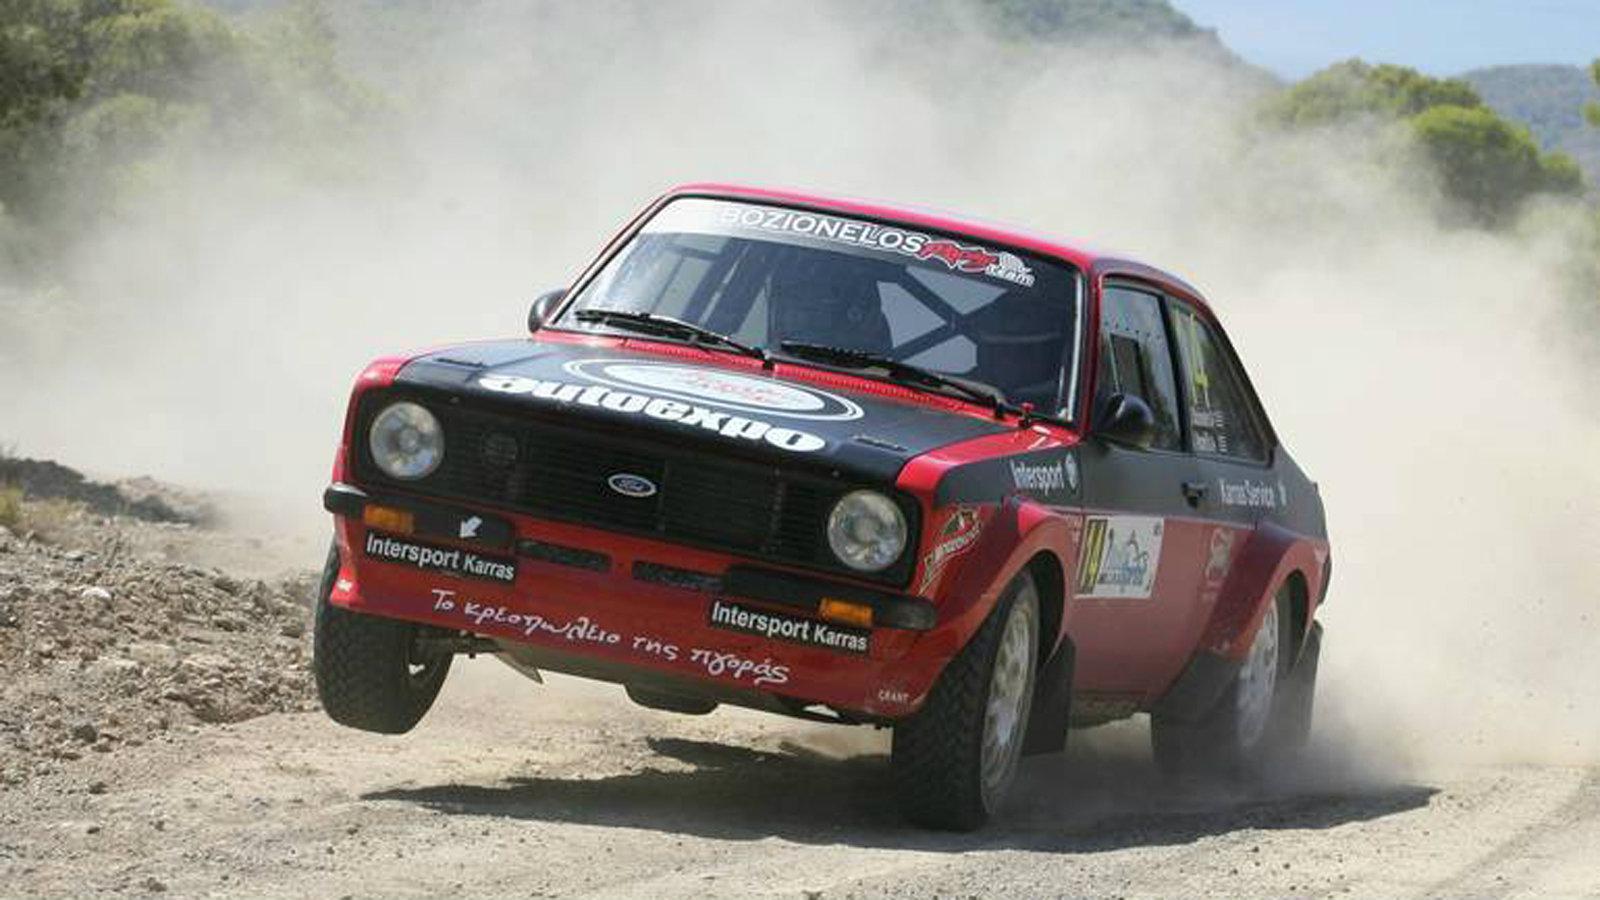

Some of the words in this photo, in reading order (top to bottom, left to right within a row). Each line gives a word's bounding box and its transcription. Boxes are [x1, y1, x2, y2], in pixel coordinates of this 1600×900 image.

[720, 205, 929, 255] BOZIONELOS
[478, 374, 826, 454] autoexpo
[1009, 458, 1065, 496] Intersport
[366, 532, 461, 570] Intersport
[463, 554, 516, 581] Karras
[711, 601, 811, 639] Intersport
[813, 624, 869, 652] Karras
